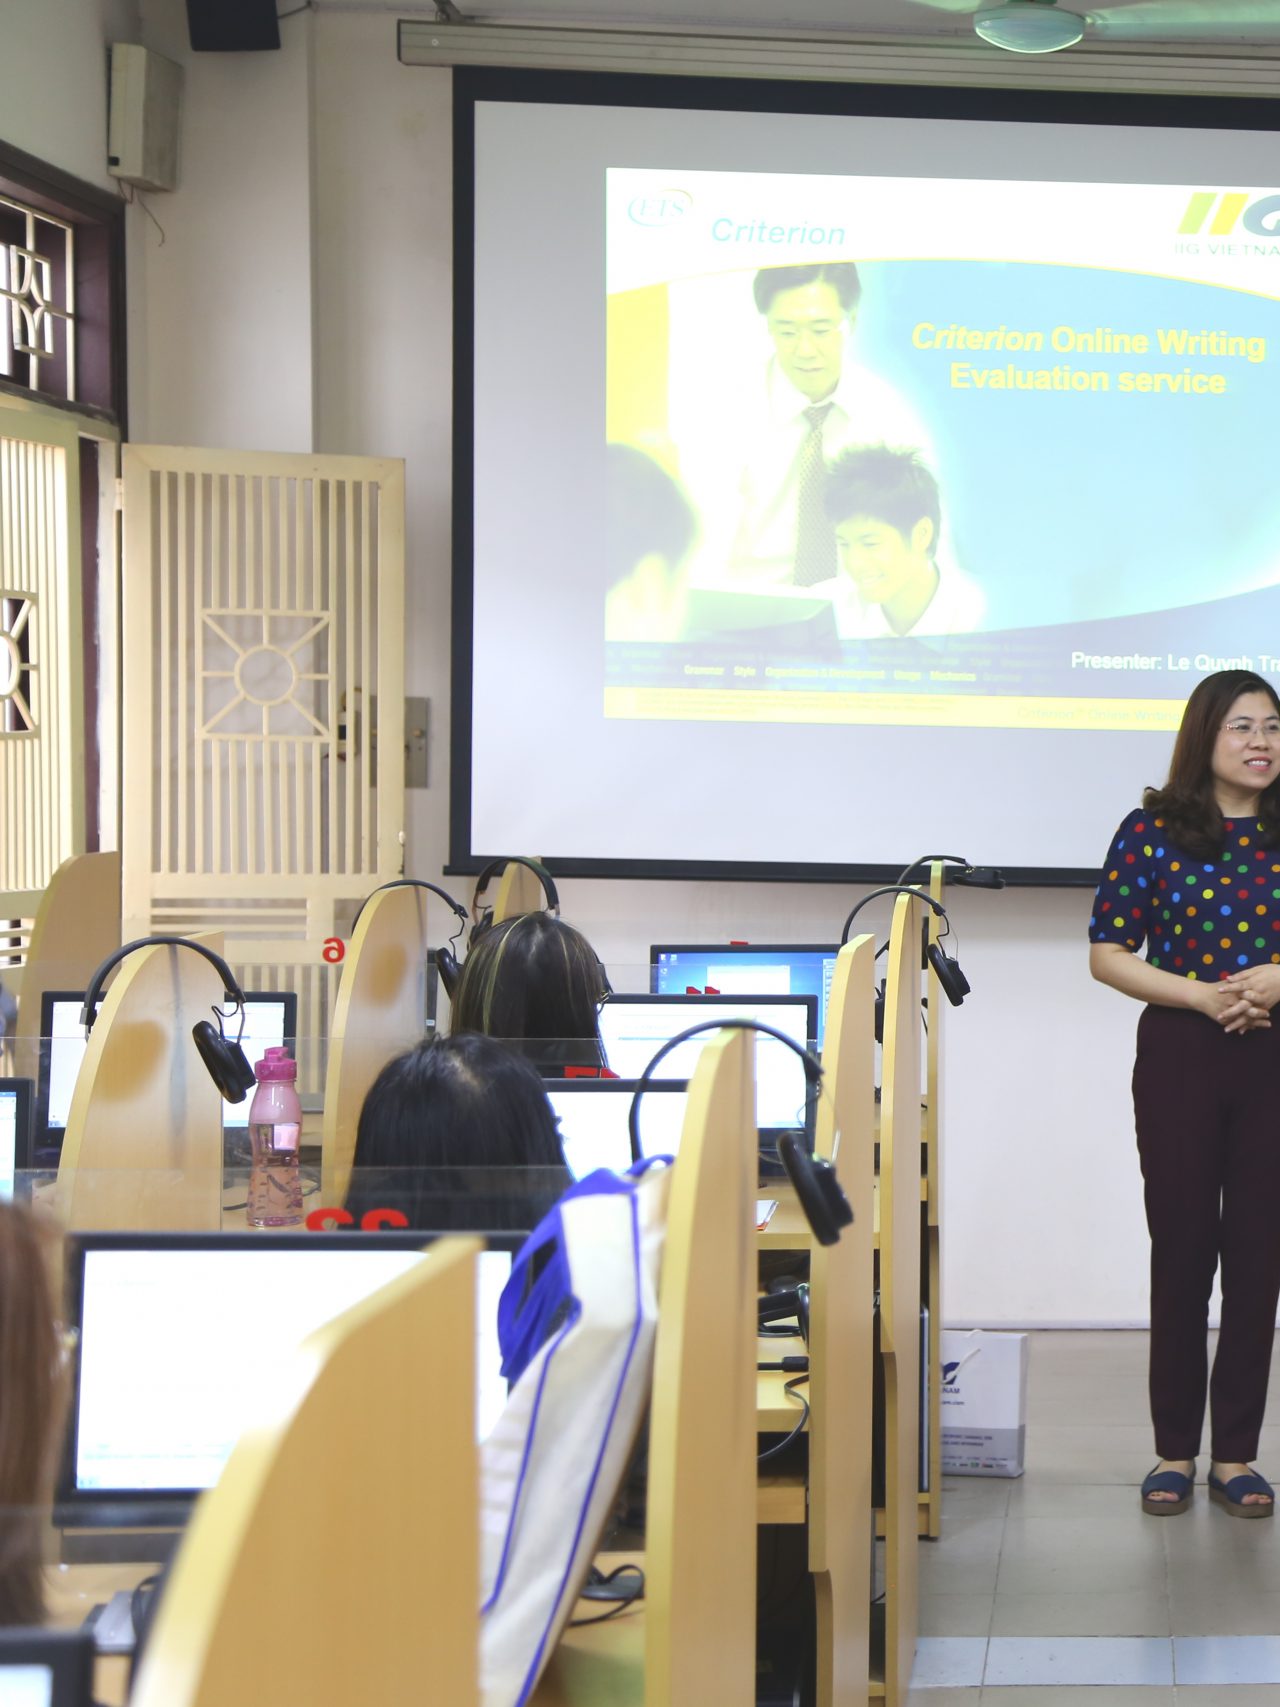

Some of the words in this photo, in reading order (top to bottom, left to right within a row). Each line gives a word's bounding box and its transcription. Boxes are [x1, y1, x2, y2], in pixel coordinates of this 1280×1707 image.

[711, 217, 847, 246] Criterion
[911, 322, 1044, 351] Criterion
[1051, 326, 1149, 353] Online
[1156, 328, 1267, 363] Writing
[950, 362, 1110, 392] Evaluation
[1117, 367, 1228, 394] service
[733, 665, 756, 678] Style
[1071, 651, 1162, 671] Presenter:
[1167, 654, 1190, 671] Le
